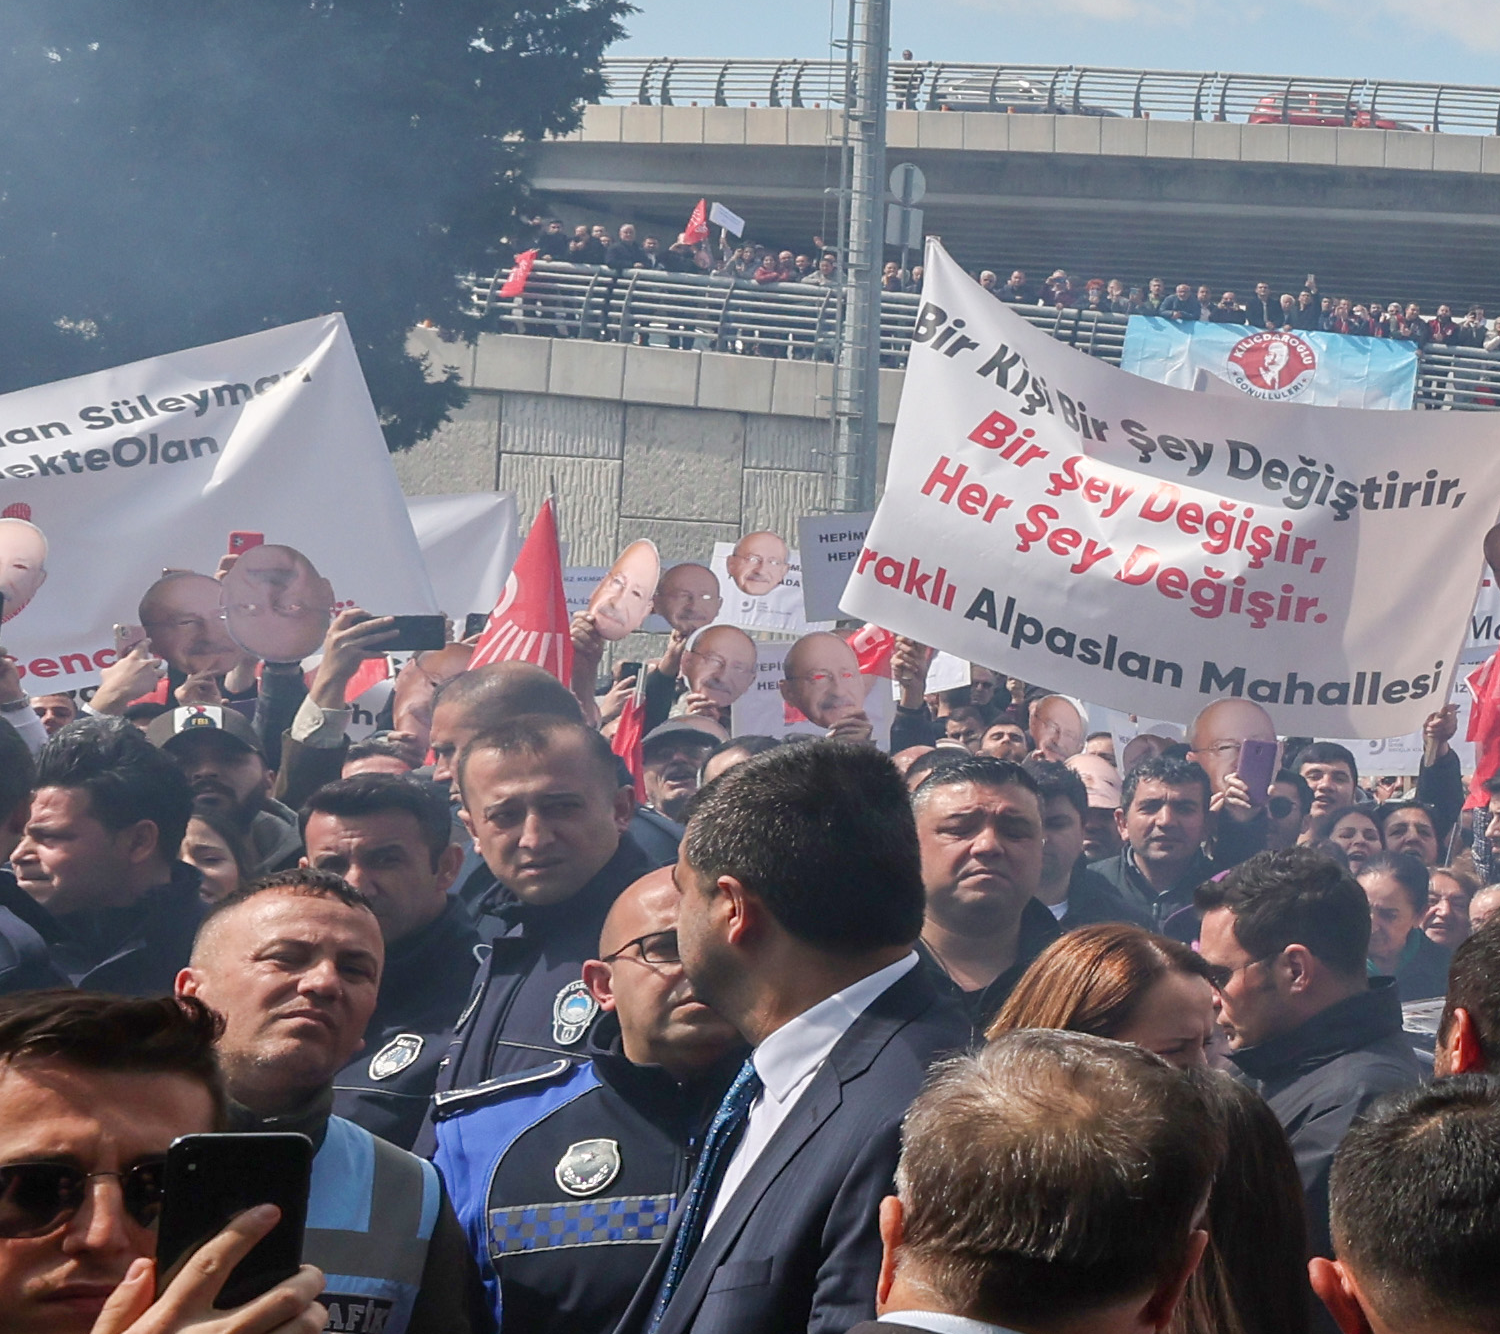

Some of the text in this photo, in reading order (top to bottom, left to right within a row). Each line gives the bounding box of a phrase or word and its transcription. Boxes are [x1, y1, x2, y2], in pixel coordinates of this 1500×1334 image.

[914, 301, 1467, 522] Bir Kişi Bir Şey Değiştirir,
[967, 410, 1328, 574] Bir Şey Değişir,
[921, 456, 1329, 629] Her Şey Değişir.
[964, 587, 1184, 689] Alpaslan
[1199, 659, 1442, 707] Mahallesi
